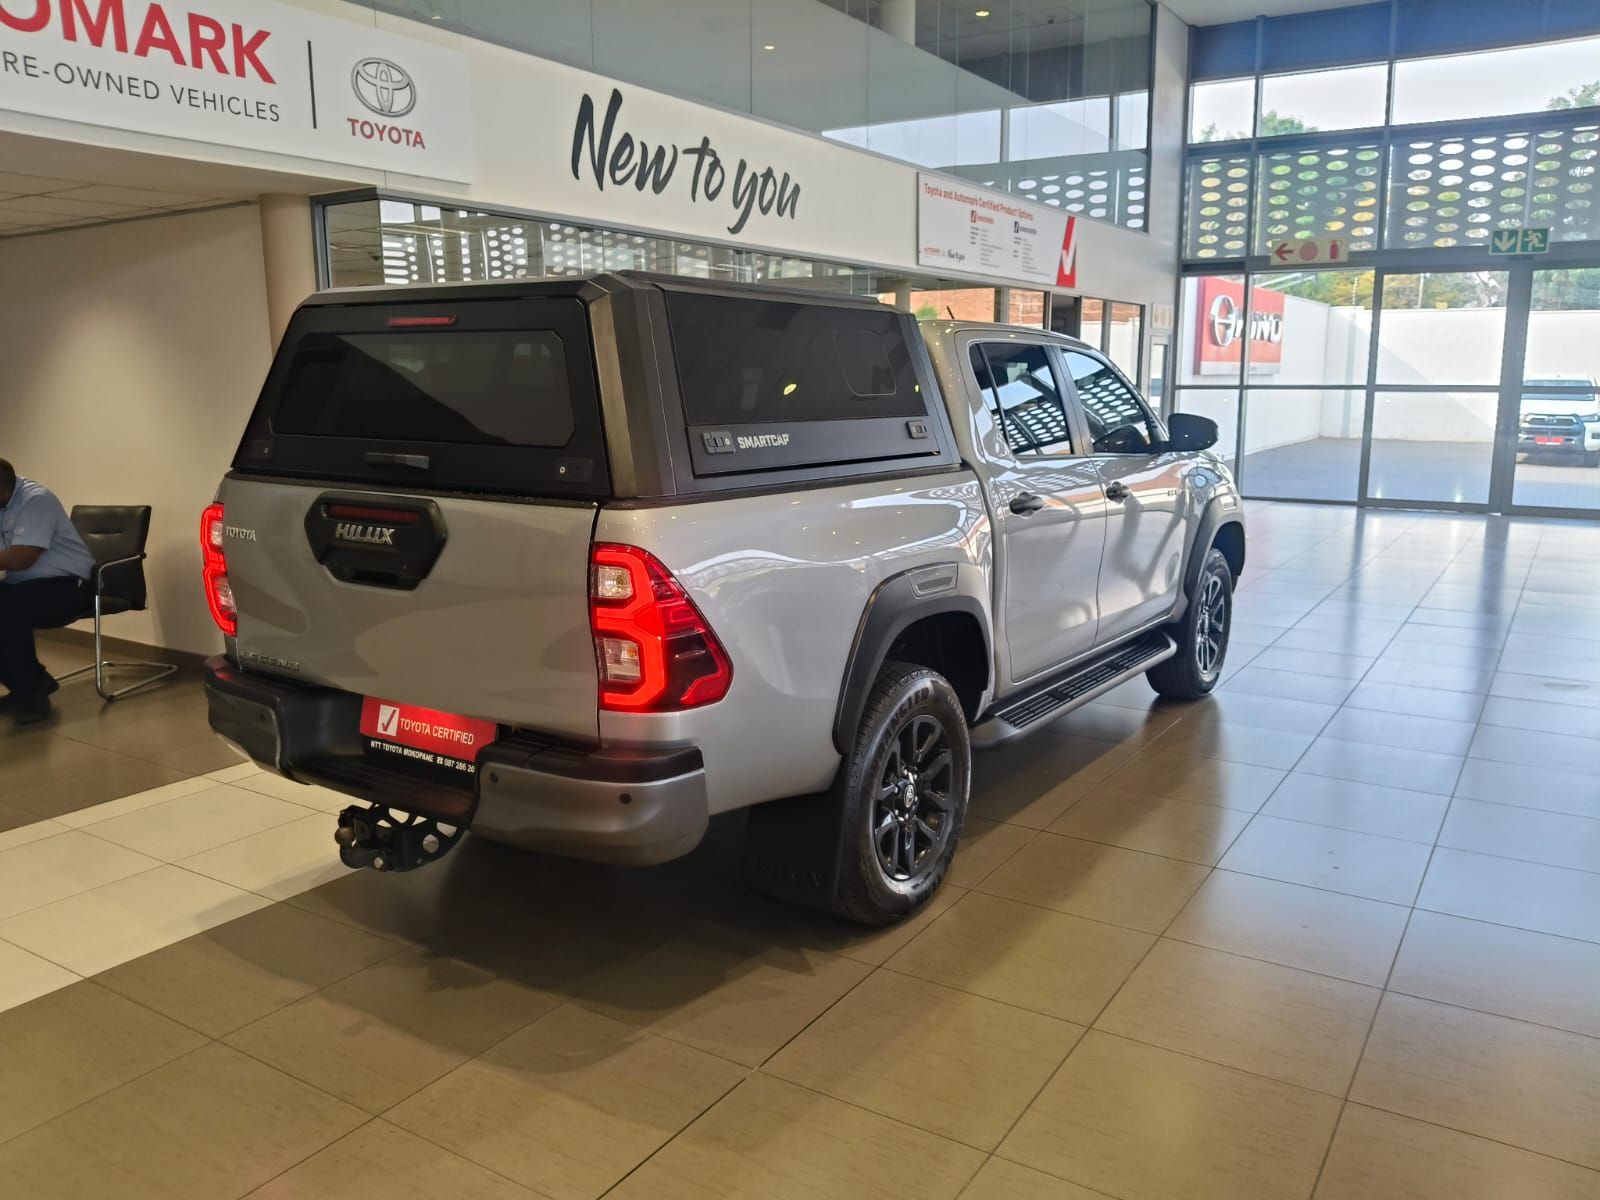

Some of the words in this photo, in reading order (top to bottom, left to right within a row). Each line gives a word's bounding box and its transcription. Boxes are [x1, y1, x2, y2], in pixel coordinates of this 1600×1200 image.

[2, 50, 160, 101] RE-OWNED
[170, 84, 280, 123] VEHICLES
[347, 118, 426, 150] TOYOTA
[571, 88, 678, 195] New
[682, 136, 725, 203] to
[727, 158, 801, 235] you
[737, 433, 790, 449] SMARTCAP
[225, 525, 256, 542] TOYOTA
[335, 522, 396, 545] HILUX
[400, 718, 431, 736] TOYOTA
[432, 725, 474, 745] CERTIFIED
[370, 740, 382, 750] NTT
[382, 743, 402, 755] TOYOTA
[403, 748, 434, 763] MOKOPANE
